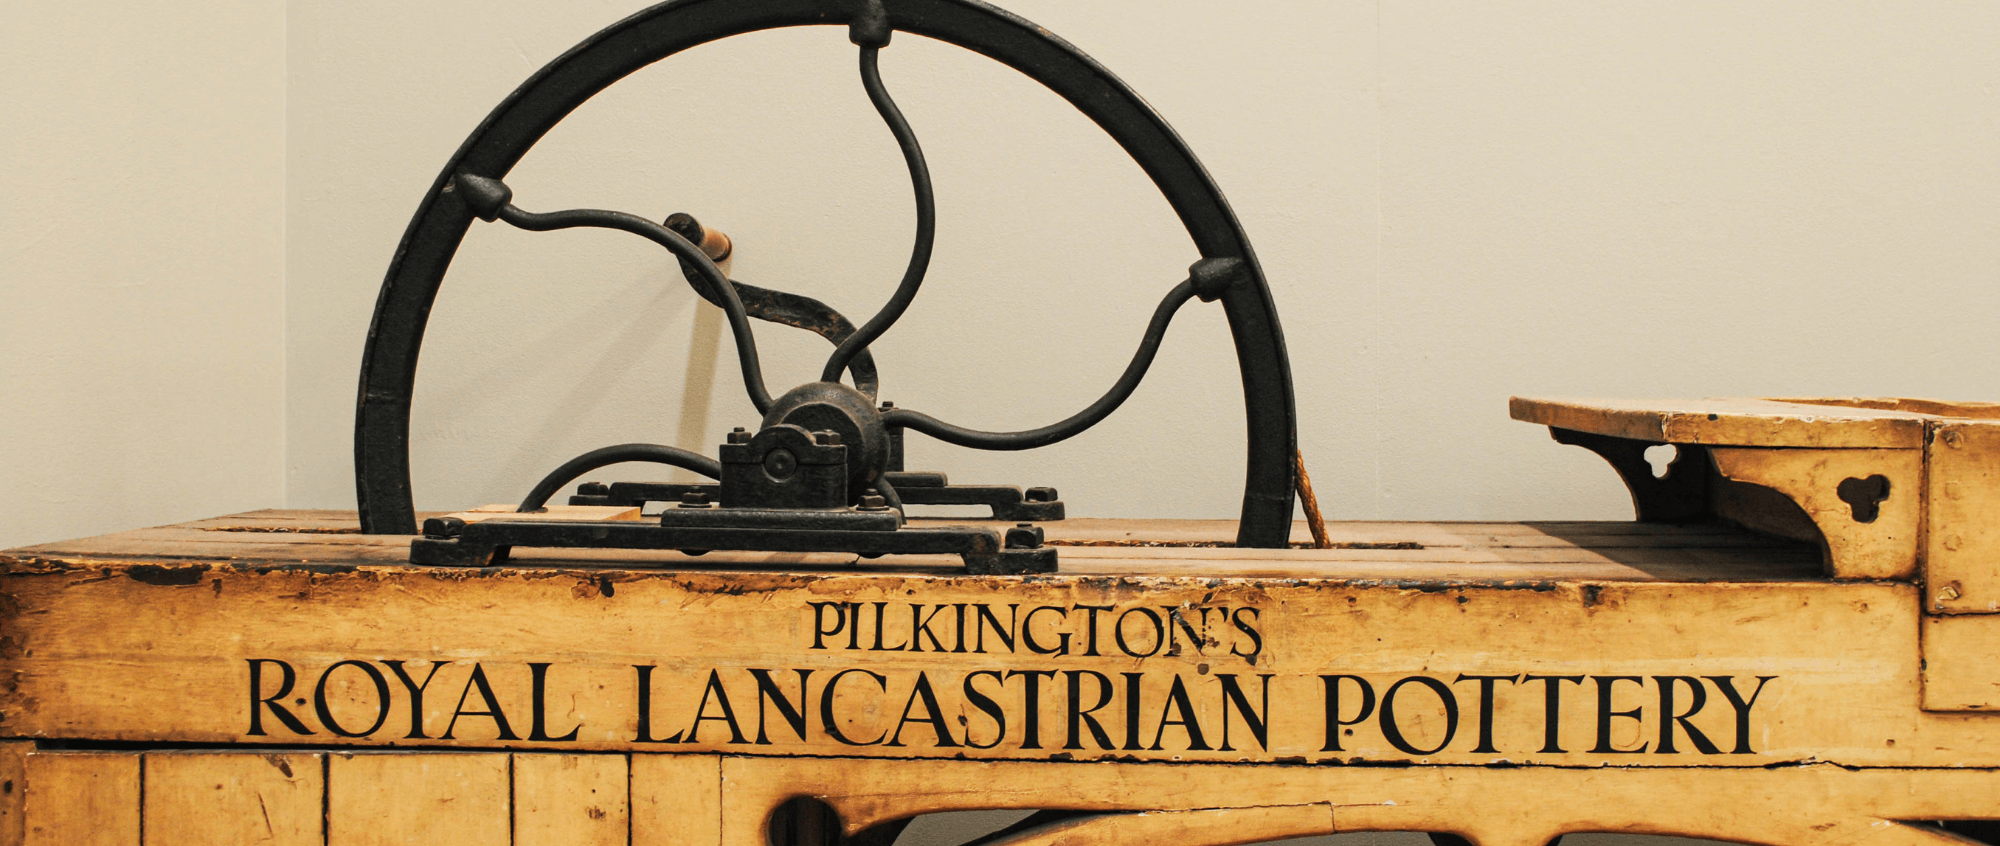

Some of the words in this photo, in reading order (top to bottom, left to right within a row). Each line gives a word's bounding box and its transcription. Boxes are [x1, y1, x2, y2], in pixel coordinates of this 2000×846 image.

[806, 600, 1263, 659] PILKINGTON'S
[245, 658, 582, 742] ROYAL
[631, 664, 1276, 753] LANCASTRIAN
[1318, 673, 1779, 756] POTTERY
